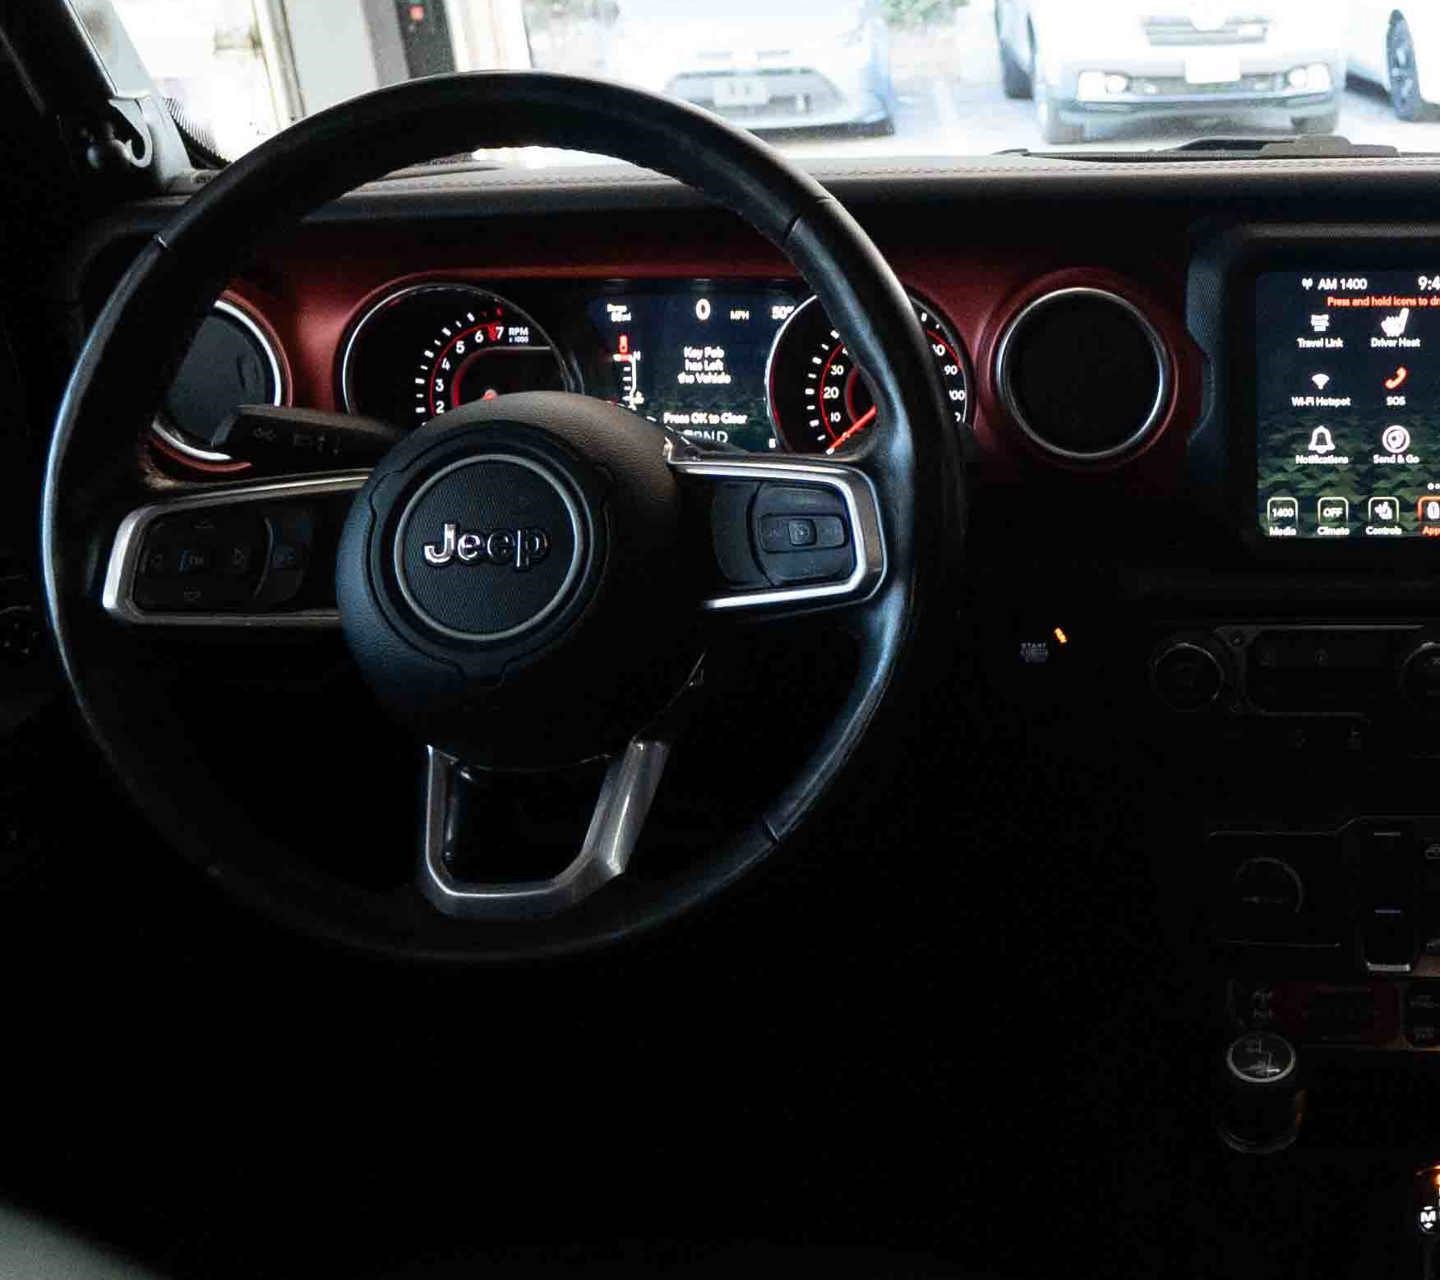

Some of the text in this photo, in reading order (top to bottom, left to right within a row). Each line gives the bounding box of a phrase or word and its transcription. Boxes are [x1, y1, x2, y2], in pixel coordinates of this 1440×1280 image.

[1317, 278, 1368, 290] AM 1400
[1327, 297, 1350, 306] Press
[1352, 296, 1371, 306] and
[1371, 296, 1392, 307] hold
[1393, 297, 1417, 306] icons
[1418, 297, 1428, 306] to
[695, 298, 711, 320] 0
[730, 310, 749, 320] MPH
[474, 330, 484, 343] 6
[495, 326, 504, 340] 7
[508, 327, 529, 336] RPM
[456, 341, 465, 354] 5
[1297, 337, 1344, 348] Travel Link
[1370, 337, 1421, 348] Driver Heat
[683, 346, 703, 359] Key
[441, 358, 451, 371] 4
[684, 360, 724, 371] has Left
[830, 365, 844, 376] 30
[944, 365, 958, 376] 90
[677, 372, 732, 384] the Vehicle
[435, 379, 444, 392] 3
[823, 387, 839, 399] 20
[1291, 396, 1351, 408] Wi-Fi Hotspot
[1386, 396, 1406, 406] SOS
[436, 401, 445, 414] 2
[663, 412, 748, 424] Press OK to Clear
[830, 412, 841, 423] 10
[1295, 454, 1349, 464] Notifications
[1373, 454, 1396, 464] Send
[1406, 454, 1420, 464] Go
[1272, 508, 1295, 518] 1400
[1323, 507, 1344, 518] OFF
[1269, 526, 1297, 536] Media
[1317, 526, 1350, 536] Climate
[1365, 526, 1402, 536] Controls
[423, 523, 550, 570] Jeep
[1420, 1211, 1436, 1222] M
